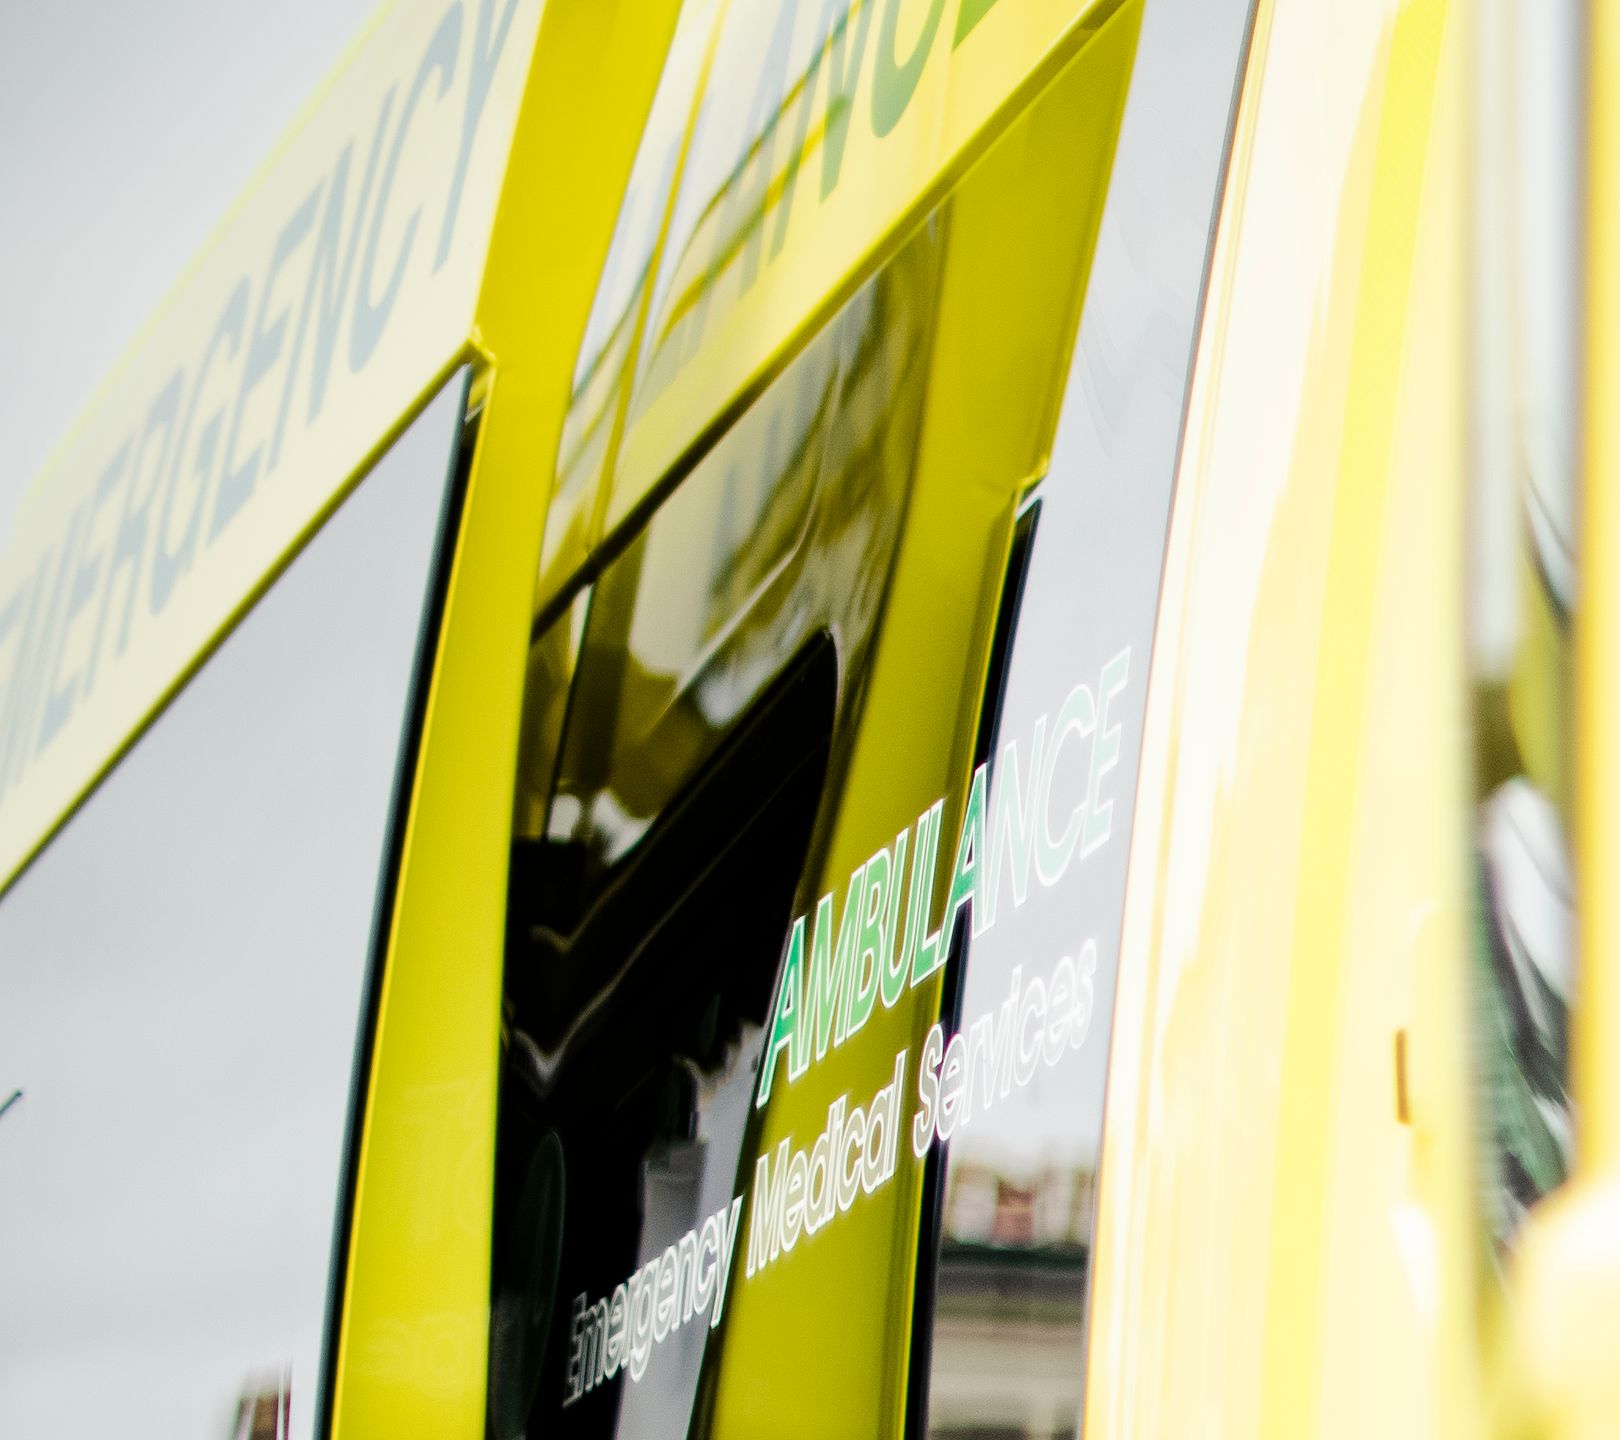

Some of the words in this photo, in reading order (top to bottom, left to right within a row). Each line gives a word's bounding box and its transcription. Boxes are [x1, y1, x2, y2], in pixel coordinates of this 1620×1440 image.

[0, 0, 520, 790] MERGENCY
[758, 647, 1131, 1106] AMBULANCE
[564, 1195, 744, 1408] Emergency
[748, 1048, 908, 1277] Medical
[913, 939, 1097, 1159] Services
